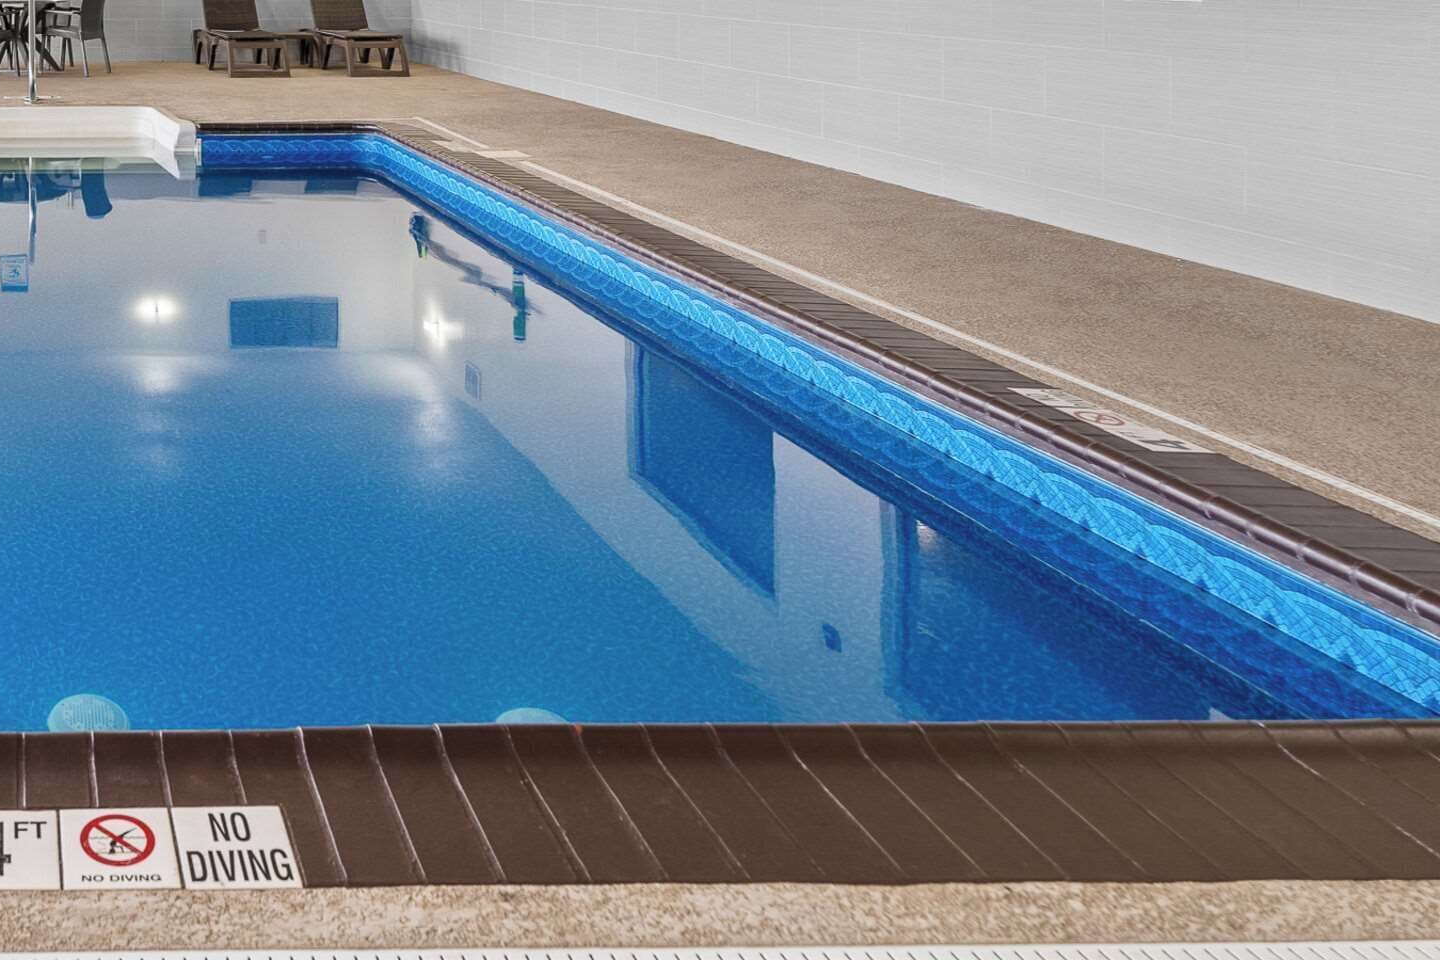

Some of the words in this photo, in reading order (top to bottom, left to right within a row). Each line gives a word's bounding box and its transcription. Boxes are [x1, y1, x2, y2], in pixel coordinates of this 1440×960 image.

[14, 821, 47, 839] FT
[208, 812, 251, 842] NO
[186, 848, 295, 882] DIVING
[109, 874, 162, 882] DIVING
